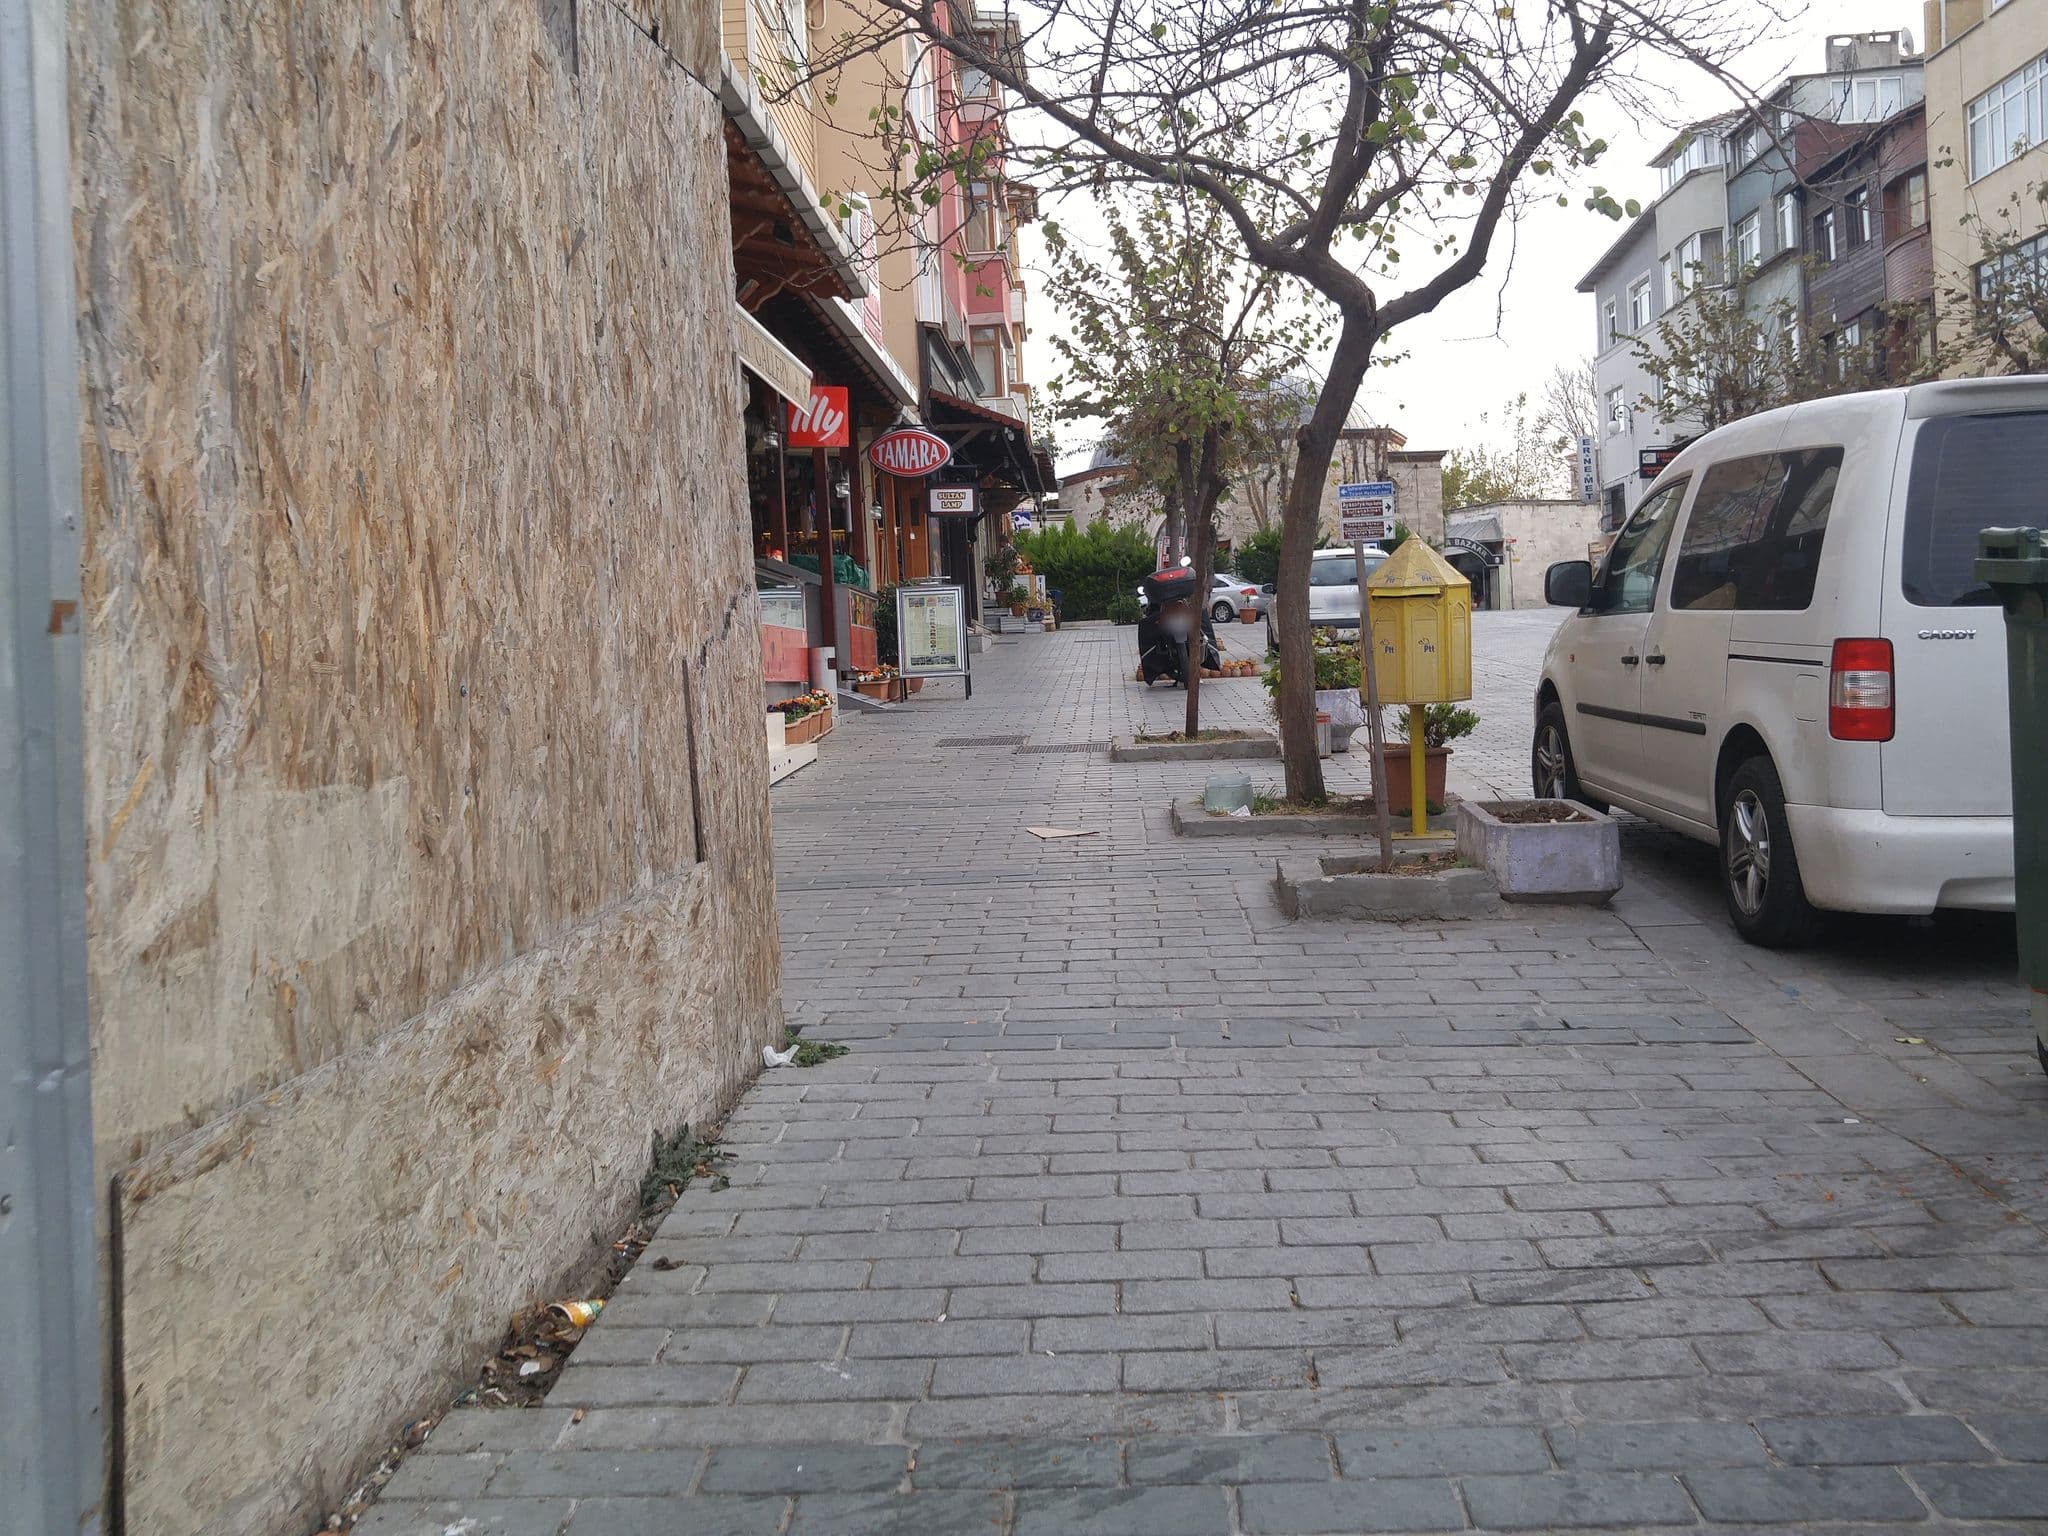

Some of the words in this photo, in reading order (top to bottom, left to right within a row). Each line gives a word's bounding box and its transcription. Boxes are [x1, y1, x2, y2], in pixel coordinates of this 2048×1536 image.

[791, 394, 844, 442] illy
[876, 438, 941, 470] TAMARA
[937, 492, 966, 500] SULTAN
[941, 501, 962, 509] LAMP
[1454, 538, 1487, 558] BAZAAR
[1918, 629, 1977, 640] CADDY
[1423, 643, 1435, 653] Ptt
